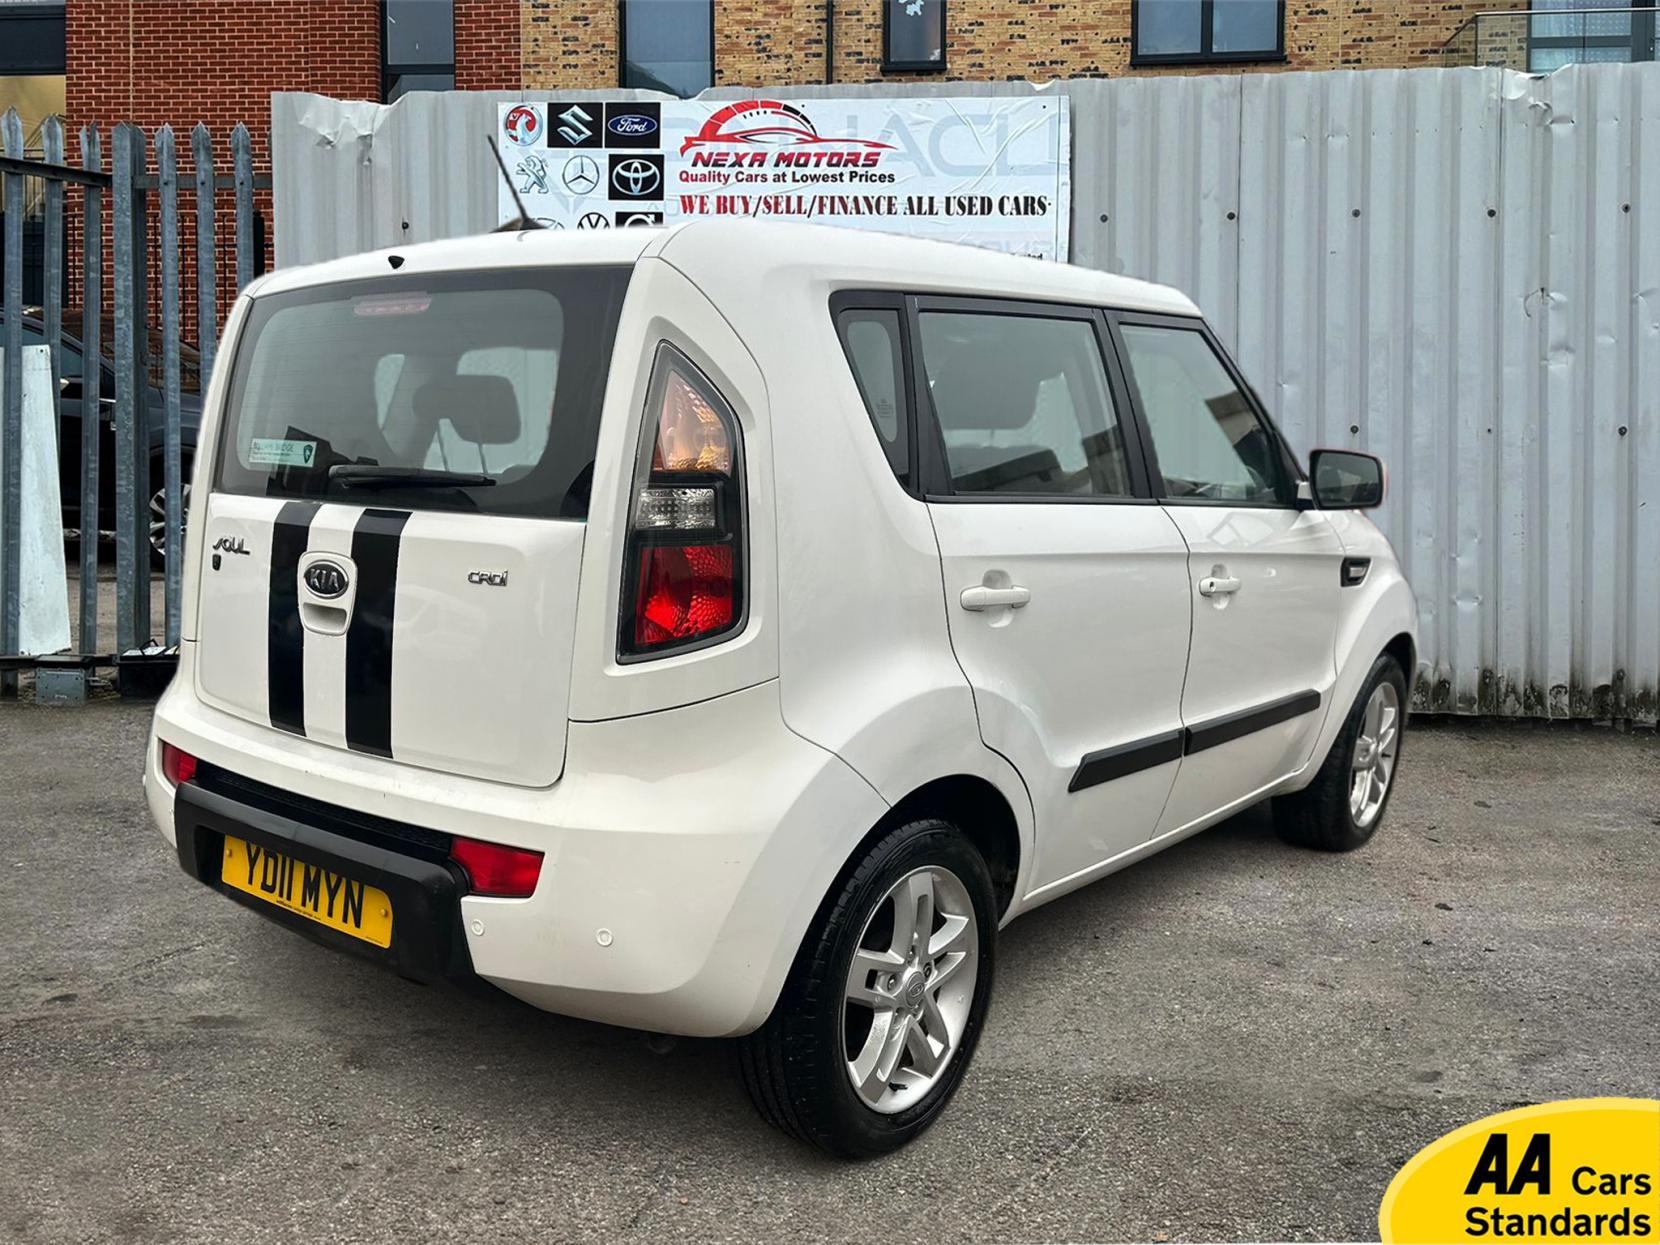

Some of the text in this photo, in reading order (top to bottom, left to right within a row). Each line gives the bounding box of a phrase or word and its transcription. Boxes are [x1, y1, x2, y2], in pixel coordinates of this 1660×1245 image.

[617, 118, 647, 132] Ford
[692, 152, 881, 168] NEXA MOTORS
[679, 171, 895, 185] Quality Cars at Lowest Prices
[680, 195, 710, 215] WE
[716, 195, 898, 218] BUY/SELL/FINANCE
[904, 196, 939, 216] ALL
[944, 196, 993, 216] USED
[998, 196, 1048, 216] CARS
[309, 568, 341, 593] KIA
[245, 841, 365, 929] YD11 MYN
